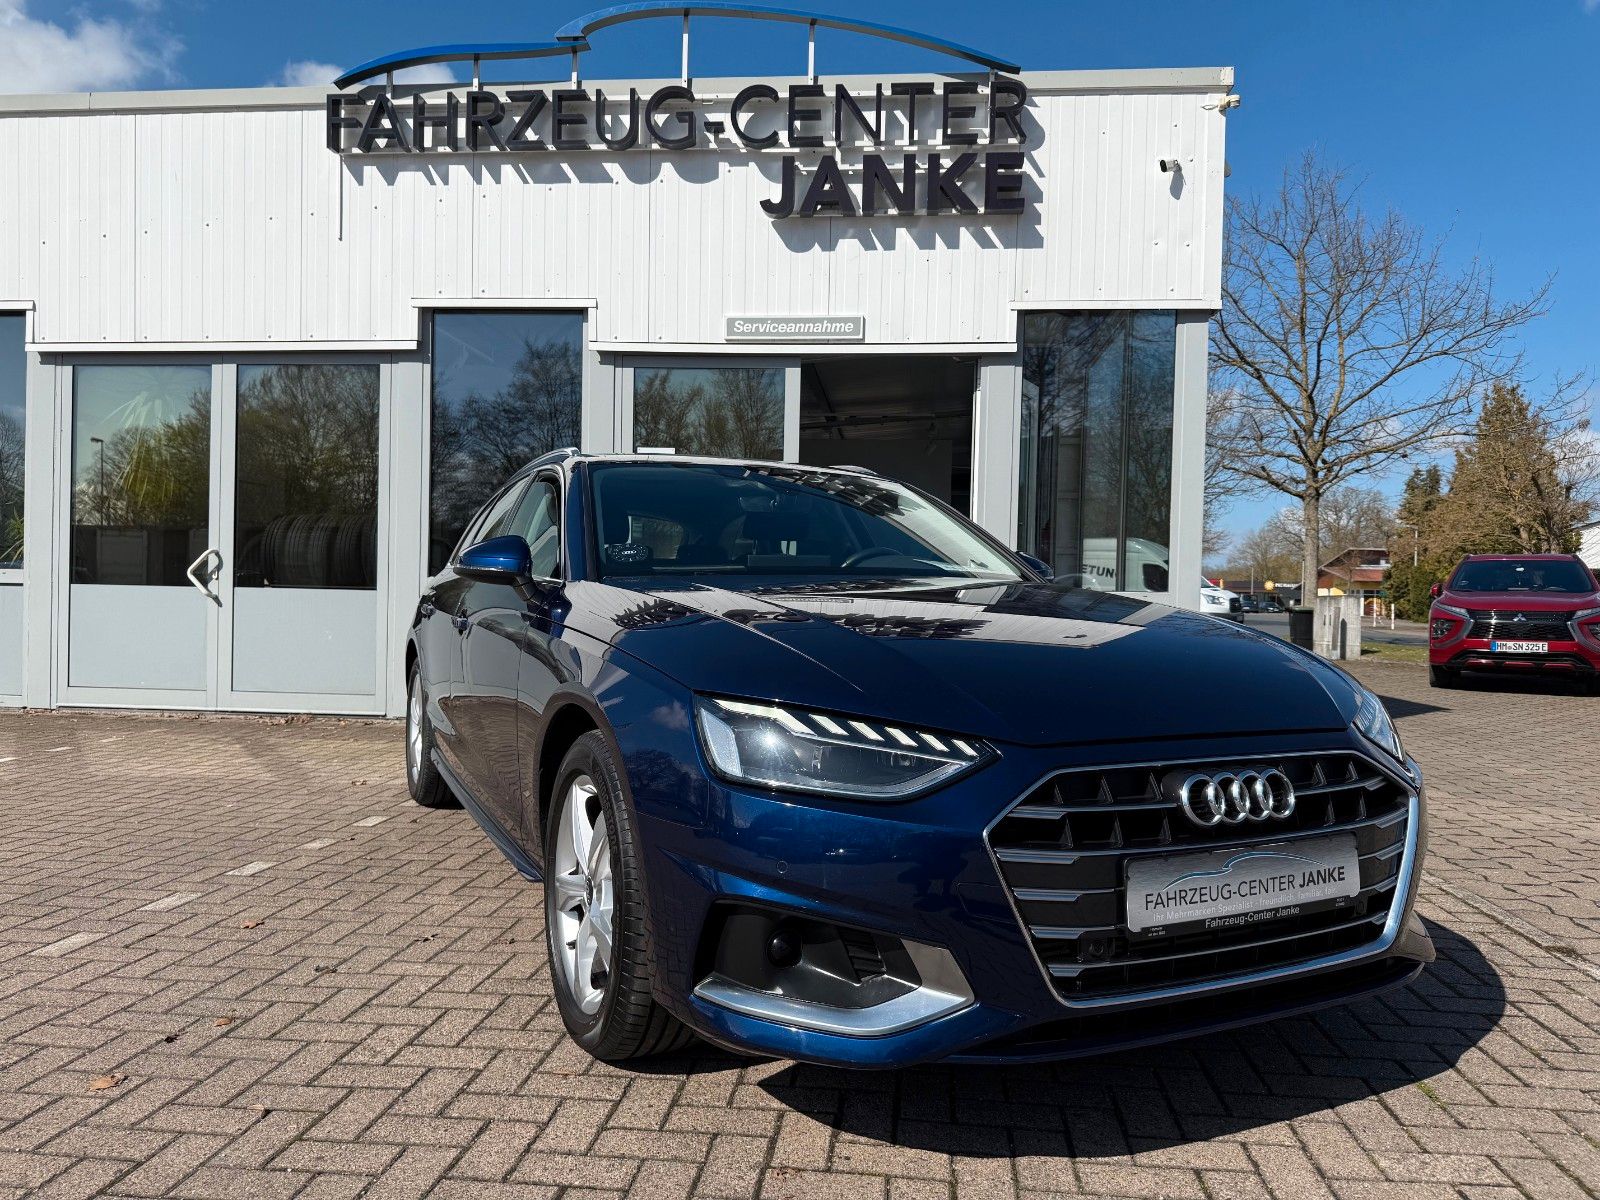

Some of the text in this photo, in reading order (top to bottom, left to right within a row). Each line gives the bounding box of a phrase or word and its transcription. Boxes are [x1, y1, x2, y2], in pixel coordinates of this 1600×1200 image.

[326, 80, 1028, 153] FAHRZEUG-CENTER
[760, 152, 1026, 219] JANKE
[733, 320, 854, 333] Serviceannahme
[1082, 563, 1117, 579] ETUN
[1497, 642, 1508, 651] HM
[1512, 642, 1524, 651] SN
[1145, 866, 1346, 911] FAHRZEUG-CENTER JANKE
[1153, 912, 1165, 922] Ihr
[1167, 905, 1217, 920] Mehrmarken
[1218, 900, 1254, 915] Spezialist
[1205, 906, 1300, 929] Fahrzeug-Center Janke
